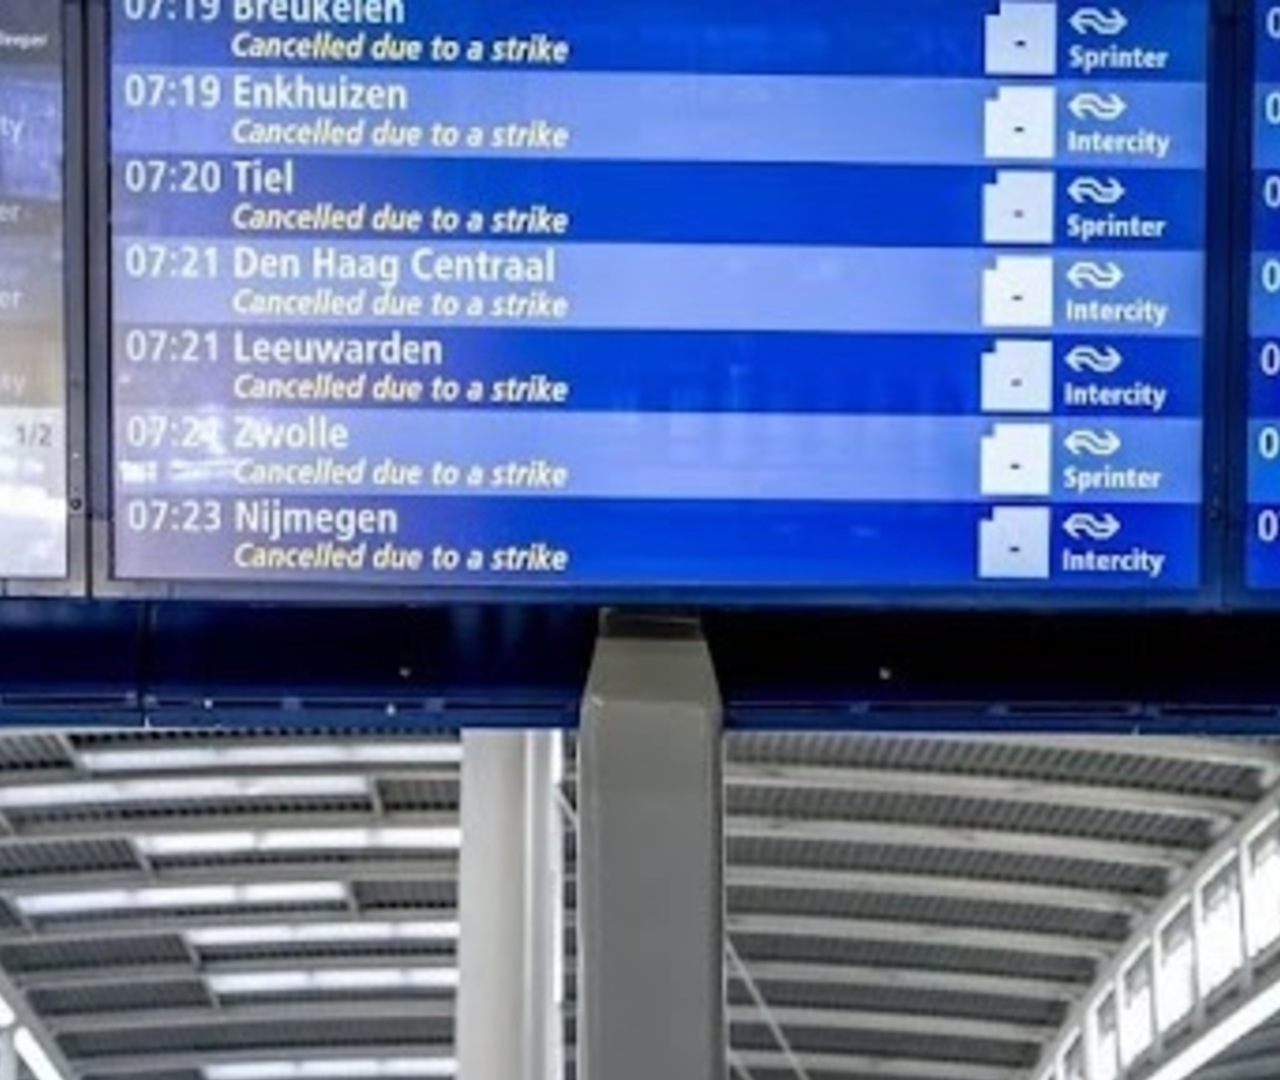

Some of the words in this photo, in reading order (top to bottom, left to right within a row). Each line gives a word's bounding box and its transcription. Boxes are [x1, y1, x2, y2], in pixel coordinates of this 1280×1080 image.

[125, 0, 220, 20] 07:19
[234, 0, 403, 22] Breukelen
[1070, 45, 1168, 72] Sprinter
[125, 74, 220, 108] 07:19
[234, 75, 407, 109] Enkhuizen
[1068, 130, 1169, 158] Intercity
[126, 160, 220, 192] 07:20
[234, 160, 292, 193] Tiel
[233, 203, 364, 230] Cancelled
[372, 204, 422, 231] due
[432, 208, 460, 232] to
[466, 212, 483, 232] a
[491, 206, 568, 233] strike
[1068, 214, 1166, 241] Sprinter
[126, 244, 216, 277] 07:21
[235, 247, 300, 277] Den
[314, 248, 399, 287] Haag
[412, 248, 554, 281] Centraal
[1067, 300, 1167, 326] Intercity
[126, 330, 217, 361] 07:21
[235, 331, 442, 364] Leeuwarden
[1065, 383, 1166, 410] Intercity
[16, 424, 51, 447] 1/2
[235, 416, 348, 448] Zwolle
[1064, 466, 1161, 492] Sprinter
[129, 500, 221, 532] 07:23
[237, 500, 397, 538] Nijmegen
[235, 543, 366, 568] Cancelled
[373, 544, 422, 569] due
[433, 546, 460, 570] to
[467, 550, 483, 570] a
[491, 544, 568, 570] strike
[1063, 548, 1164, 577] Intercity
